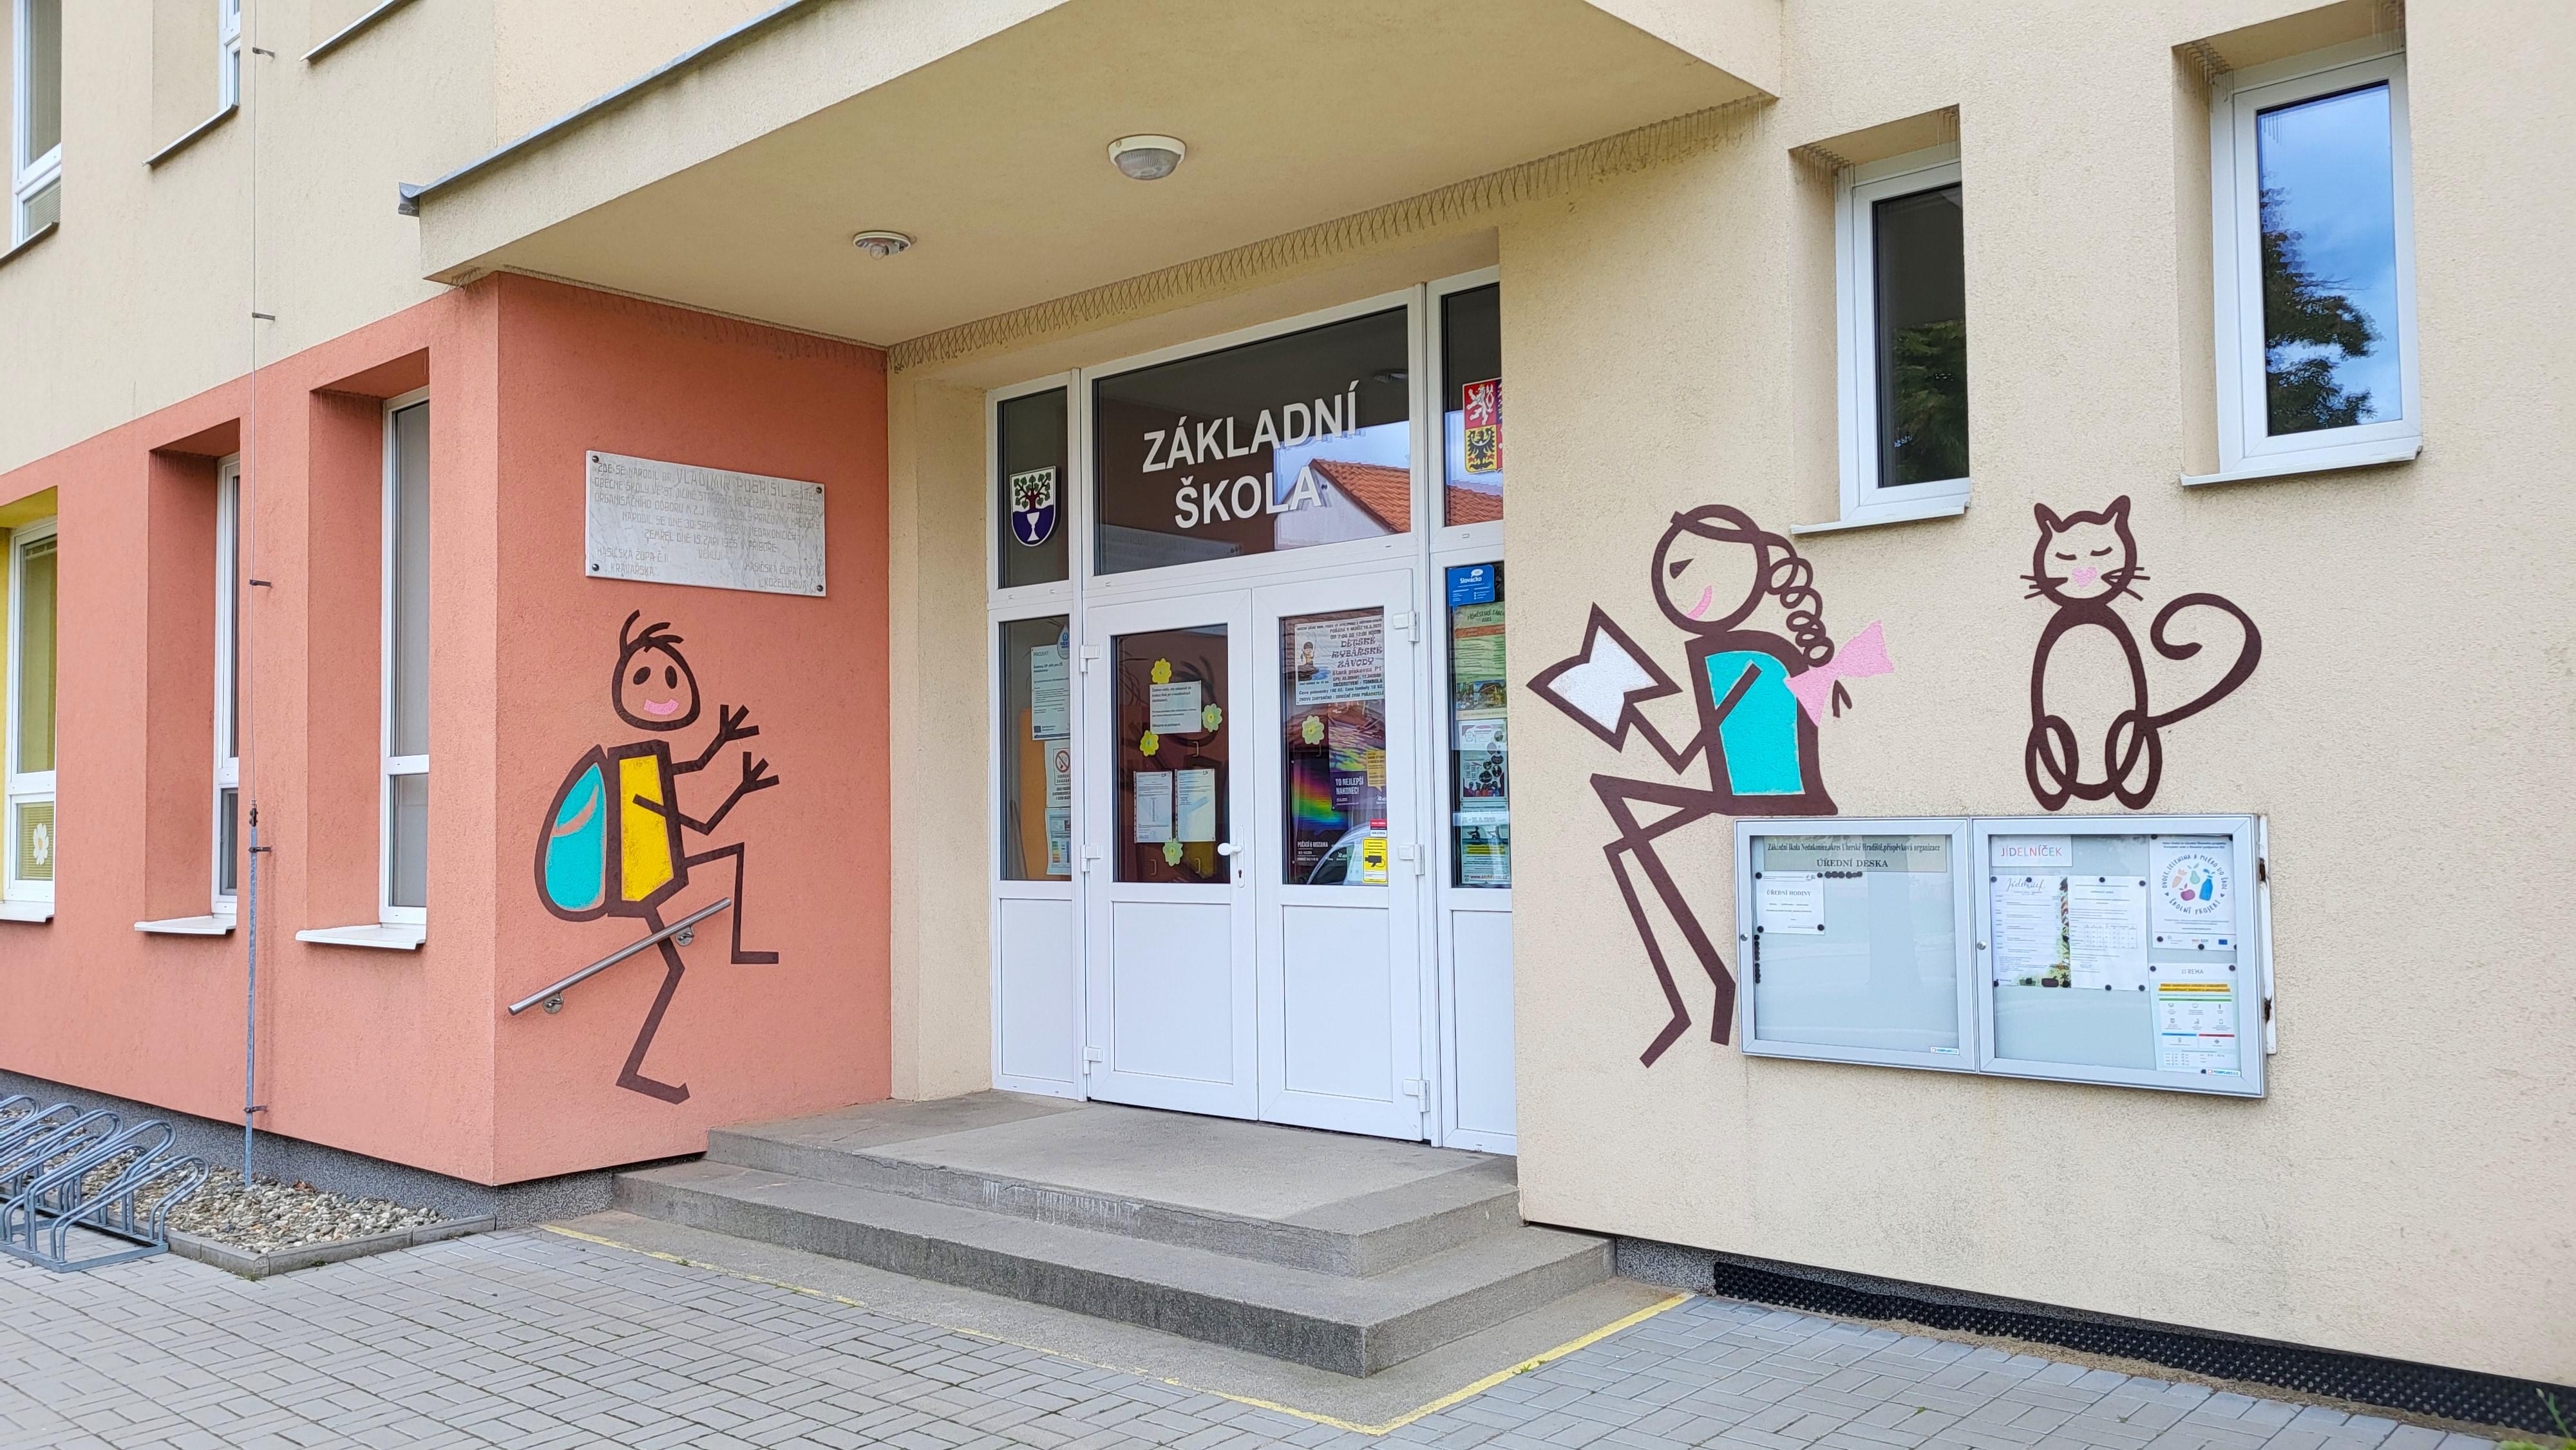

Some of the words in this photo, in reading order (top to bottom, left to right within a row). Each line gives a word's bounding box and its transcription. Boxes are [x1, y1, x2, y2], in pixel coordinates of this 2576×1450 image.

[1142, 380, 1360, 473] ZÁKLADNÍ
[616, 464, 625, 475] SE
[629, 466, 658, 480] NARODIL
[1175, 466, 1321, 529] ŠKOLA
[1337, 657, 1374, 668] ZÁVODY
[1342, 776, 1364, 786] NEJLEPŠÍ
[1913, 843, 1940, 852] organizace
[2001, 844, 2062, 856] JÍDELNÍČEK
[1816, 858, 1852, 867] ÚŘEDNÍ
